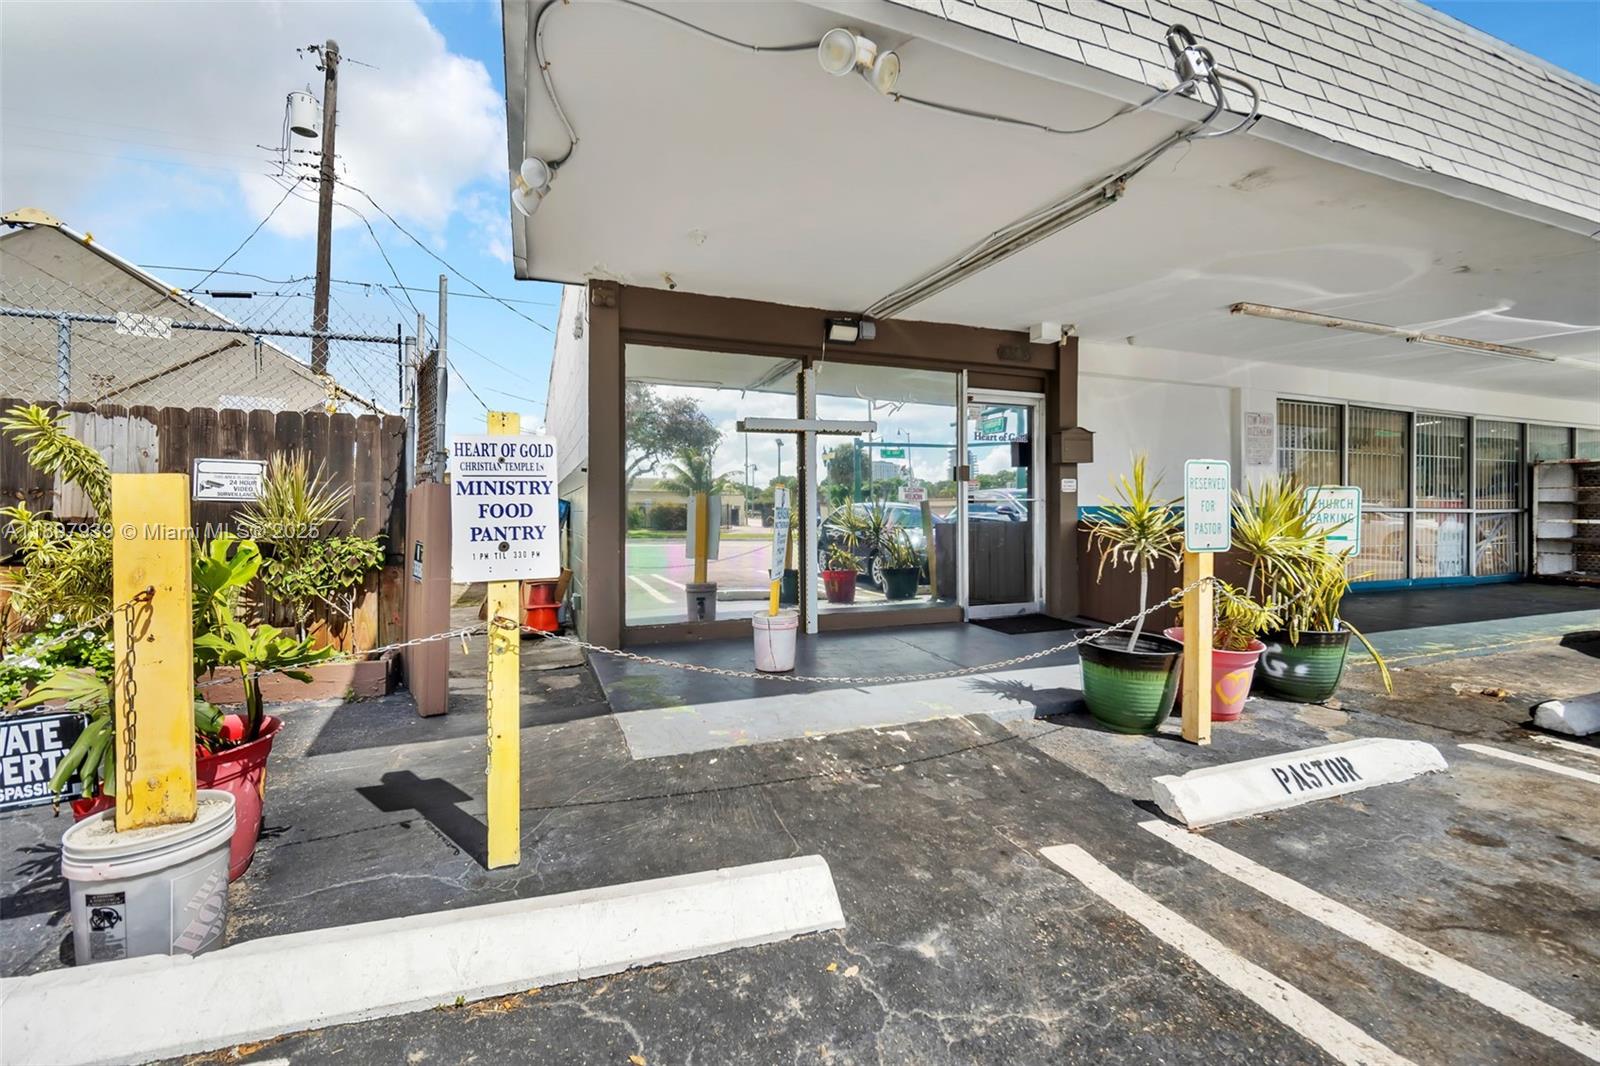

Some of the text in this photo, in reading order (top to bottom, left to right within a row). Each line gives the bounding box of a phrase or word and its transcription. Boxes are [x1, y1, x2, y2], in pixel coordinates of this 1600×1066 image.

[974, 431, 997, 442] Heart
[998, 432, 1008, 441] of
[454, 442, 554, 458] HEART OF GOLD
[460, 461, 502, 471] CHRISTIAN
[505, 462, 534, 471] TEMPLE
[456, 480, 553, 496] MINISTRY
[1189, 477, 1226, 490] RESERVED
[478, 503, 533, 518] FOOD
[1201, 500, 1215, 513] FOR
[1313, 499, 1354, 509] HURCH
[470, 525, 546, 542] PANTRY
[1194, 522, 1222, 535] PASTOR
[480, 552, 489, 560] PM
[1271, 756, 1363, 794] PASTOR
